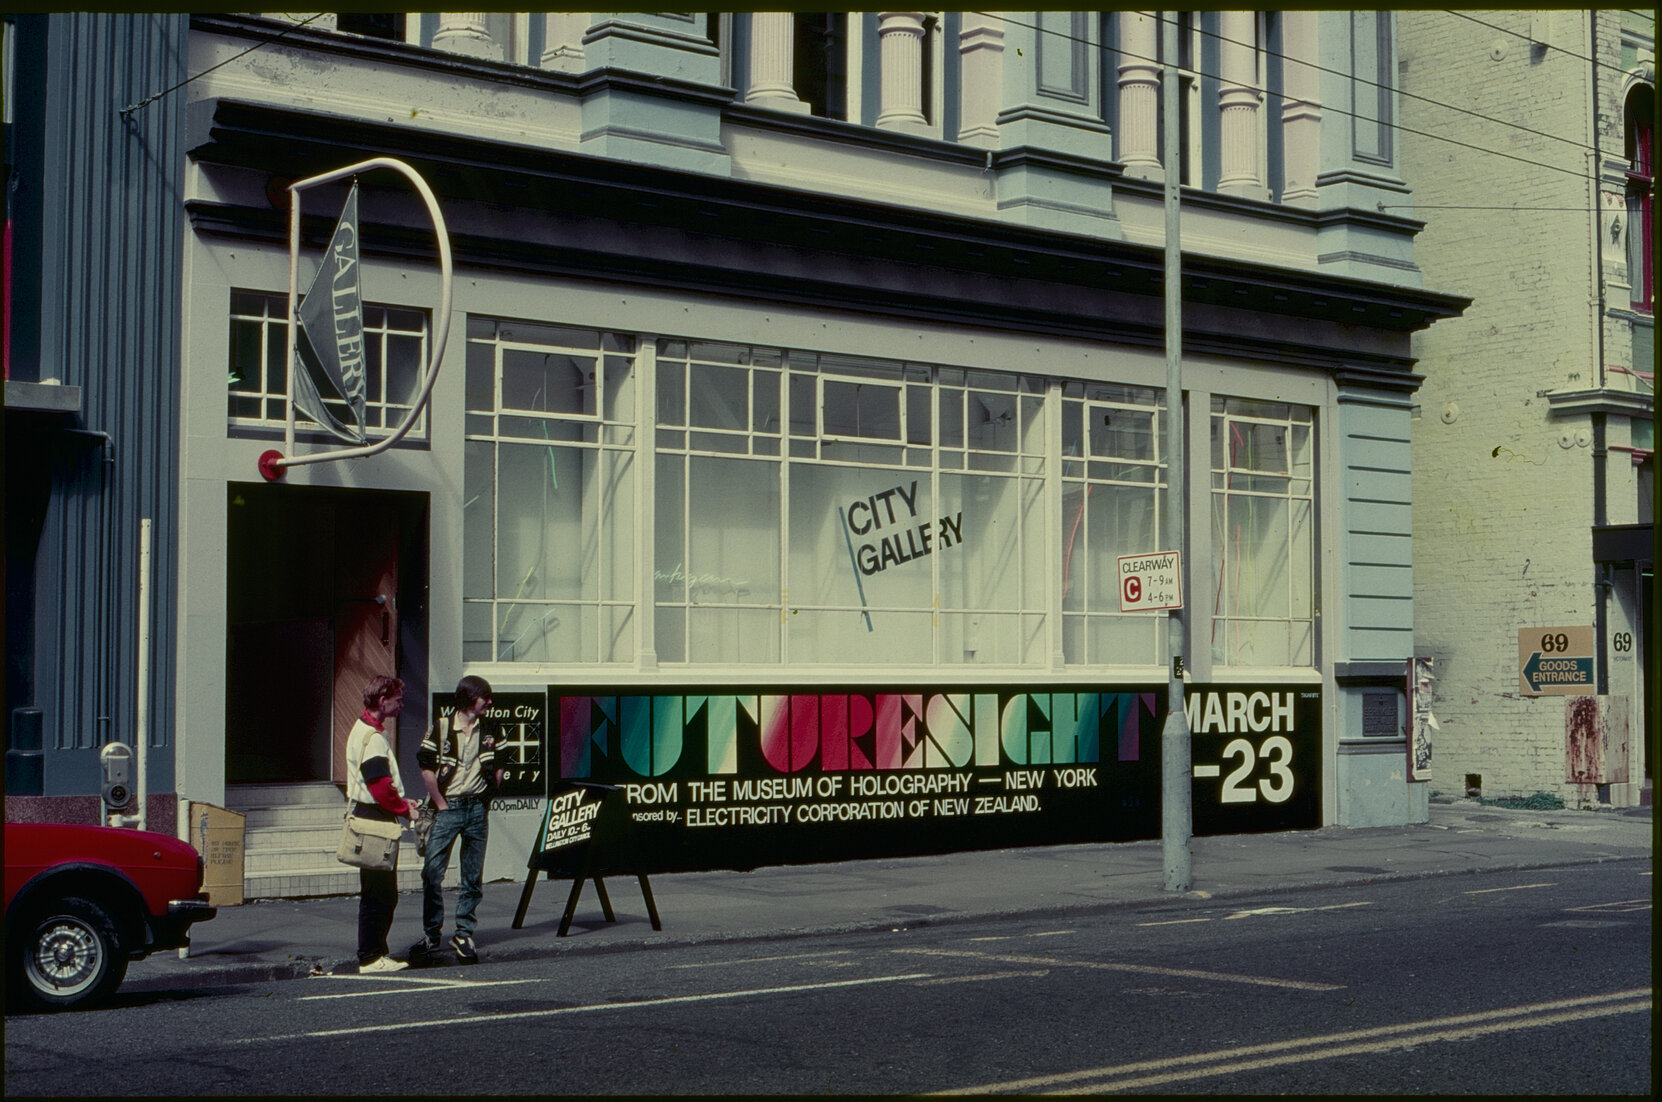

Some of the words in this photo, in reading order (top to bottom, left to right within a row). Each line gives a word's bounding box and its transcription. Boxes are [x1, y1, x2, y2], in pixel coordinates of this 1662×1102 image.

[332, 221, 366, 398] GALLERY
[848, 480, 917, 536] CITY
[857, 511, 962, 576] GALLERY
[1122, 557, 1174, 574] CLEARWAY
[1541, 633, 1569, 652] 69
[1613, 632, 1632, 652] 69
[1532, 671, 1587, 682] ENTRANCE
[1539, 661, 1577, 671] GOODS
[514, 705, 540, 720] City
[1184, 691, 1294, 733] MARCH
[559, 693, 1157, 779] FUTURESIGHT
[614, 783, 678, 804] ROM
[688, 781, 726, 802] THE
[733, 777, 812, 800] MUSEUM
[817, 775, 842, 797] OF
[851, 773, 973, 796] HOLOGRAPHY
[1006, 771, 1046, 790] NEW
[1053, 768, 1098, 787] YORK
[552, 788, 586, 814] CITY
[687, 805, 793, 827] ELECTRICITY
[797, 801, 904, 823] CORPORATION
[909, 800, 931, 818] OF
[934, 798, 970, 816] NEW
[975, 795, 1042, 815] ZEALAND.
[548, 800, 602, 832] GALLERY
[546, 829, 567, 842] DAILY
